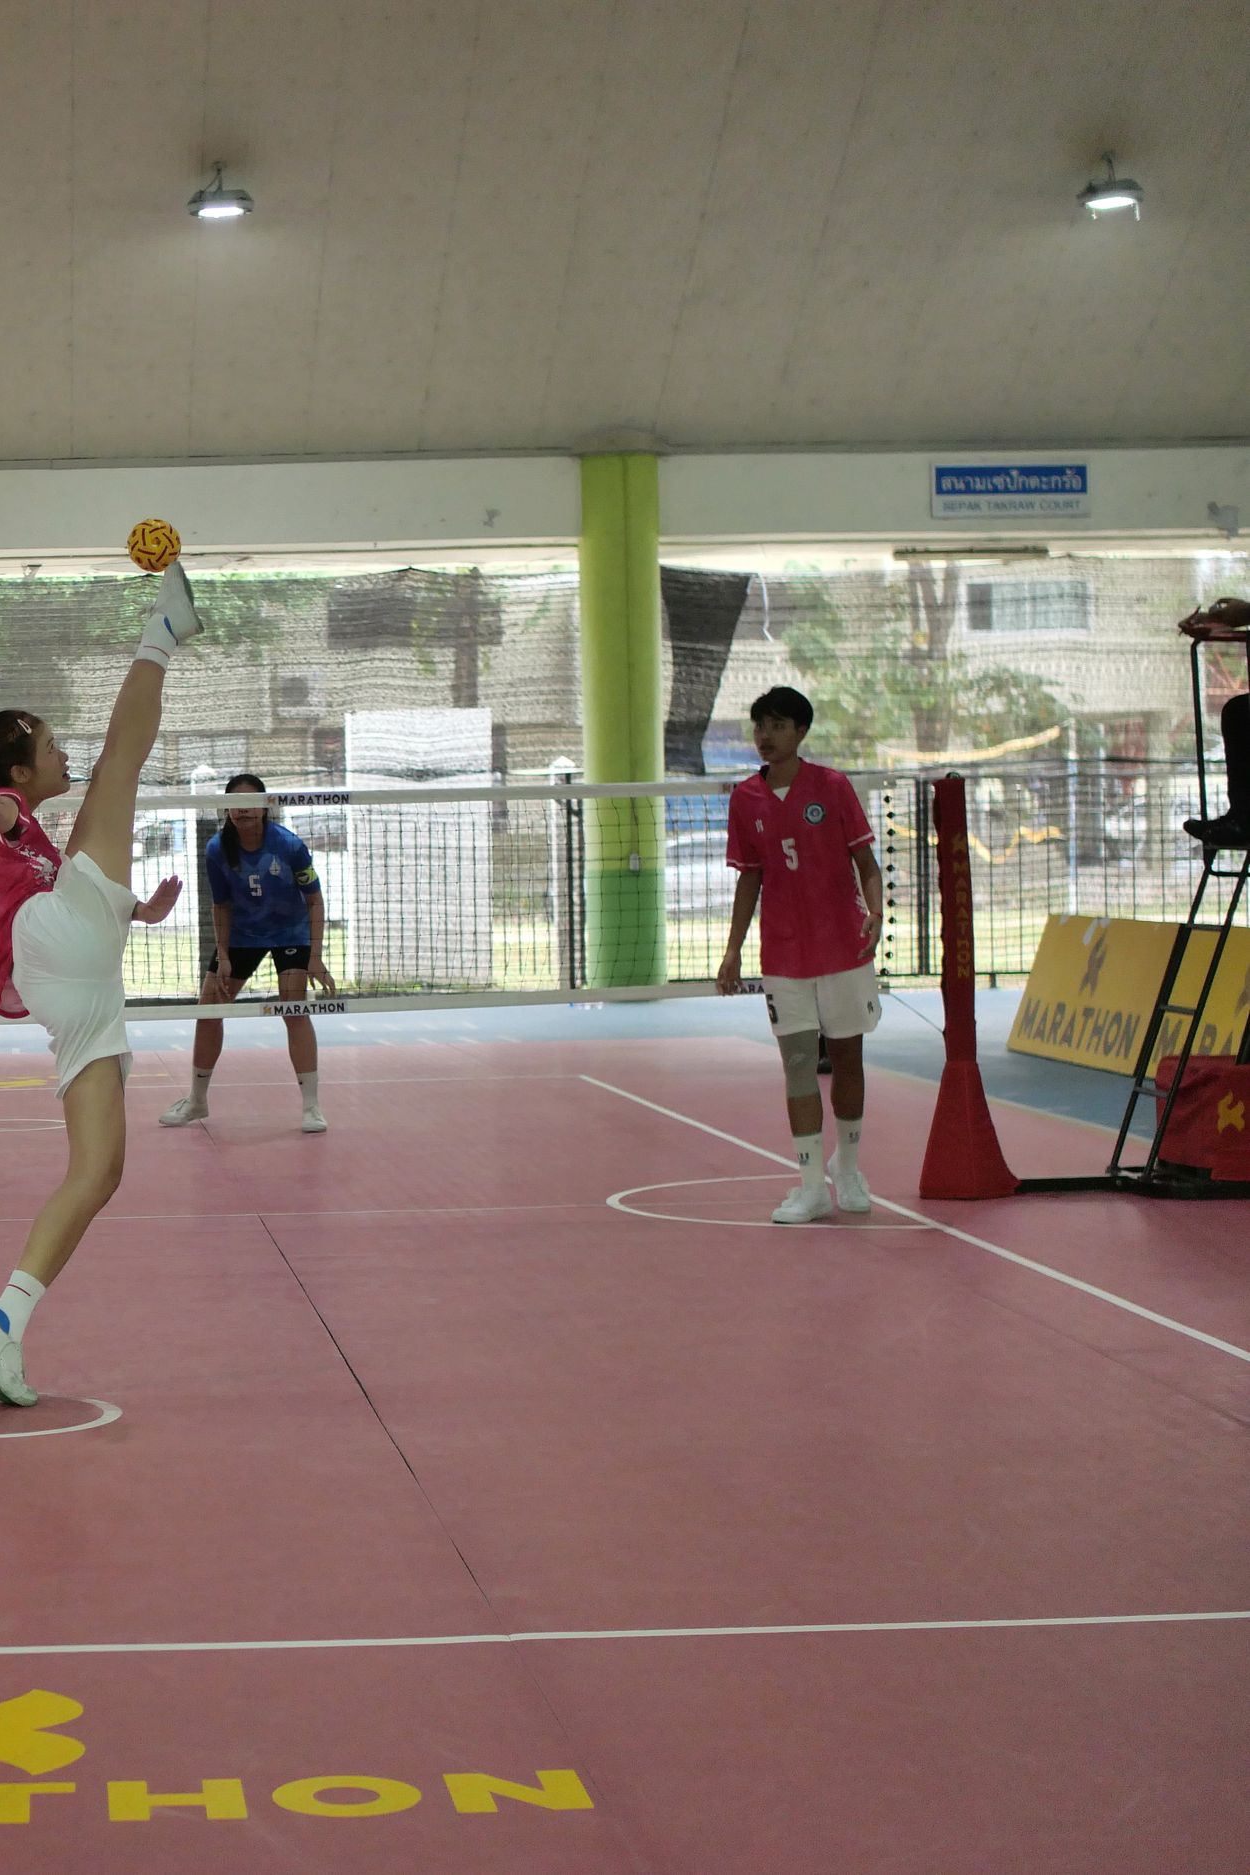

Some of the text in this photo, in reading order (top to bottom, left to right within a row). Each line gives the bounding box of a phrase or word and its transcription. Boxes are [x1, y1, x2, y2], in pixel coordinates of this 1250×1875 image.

[942, 499, 982, 511] SEPAK
[987, 499, 1036, 511] TAKRAW
[278, 794, 350, 806] MARATHON
[781, 838, 799, 871] 5
[249, 874, 263, 897] 5
[274, 1002, 345, 1015] MARATHON
[1017, 997, 1141, 1060] MARATHON
